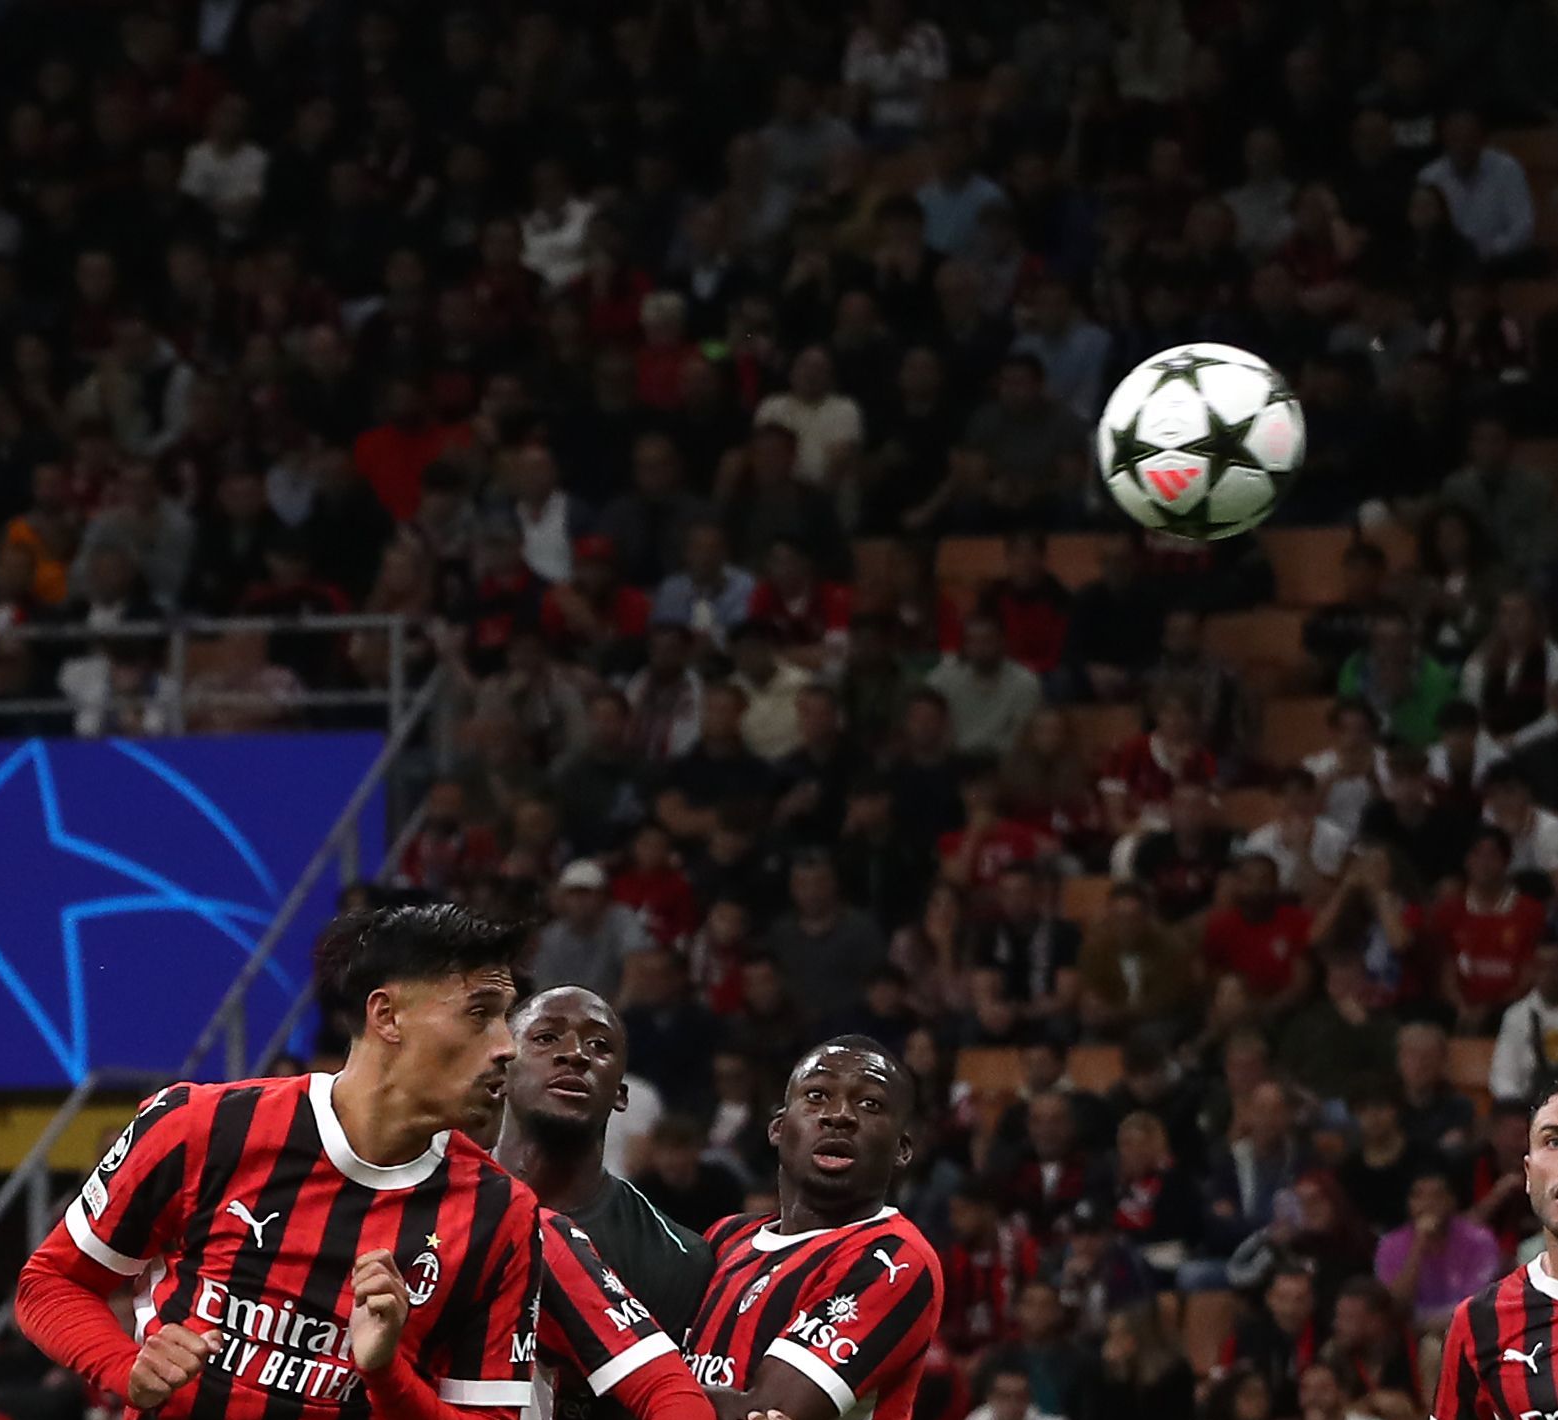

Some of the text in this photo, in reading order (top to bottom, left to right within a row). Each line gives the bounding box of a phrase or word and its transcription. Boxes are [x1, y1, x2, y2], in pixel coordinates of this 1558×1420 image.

[604, 1297, 650, 1331] MS
[786, 1309, 859, 1364] MSC
[257, 1349, 361, 1402] BETTER
